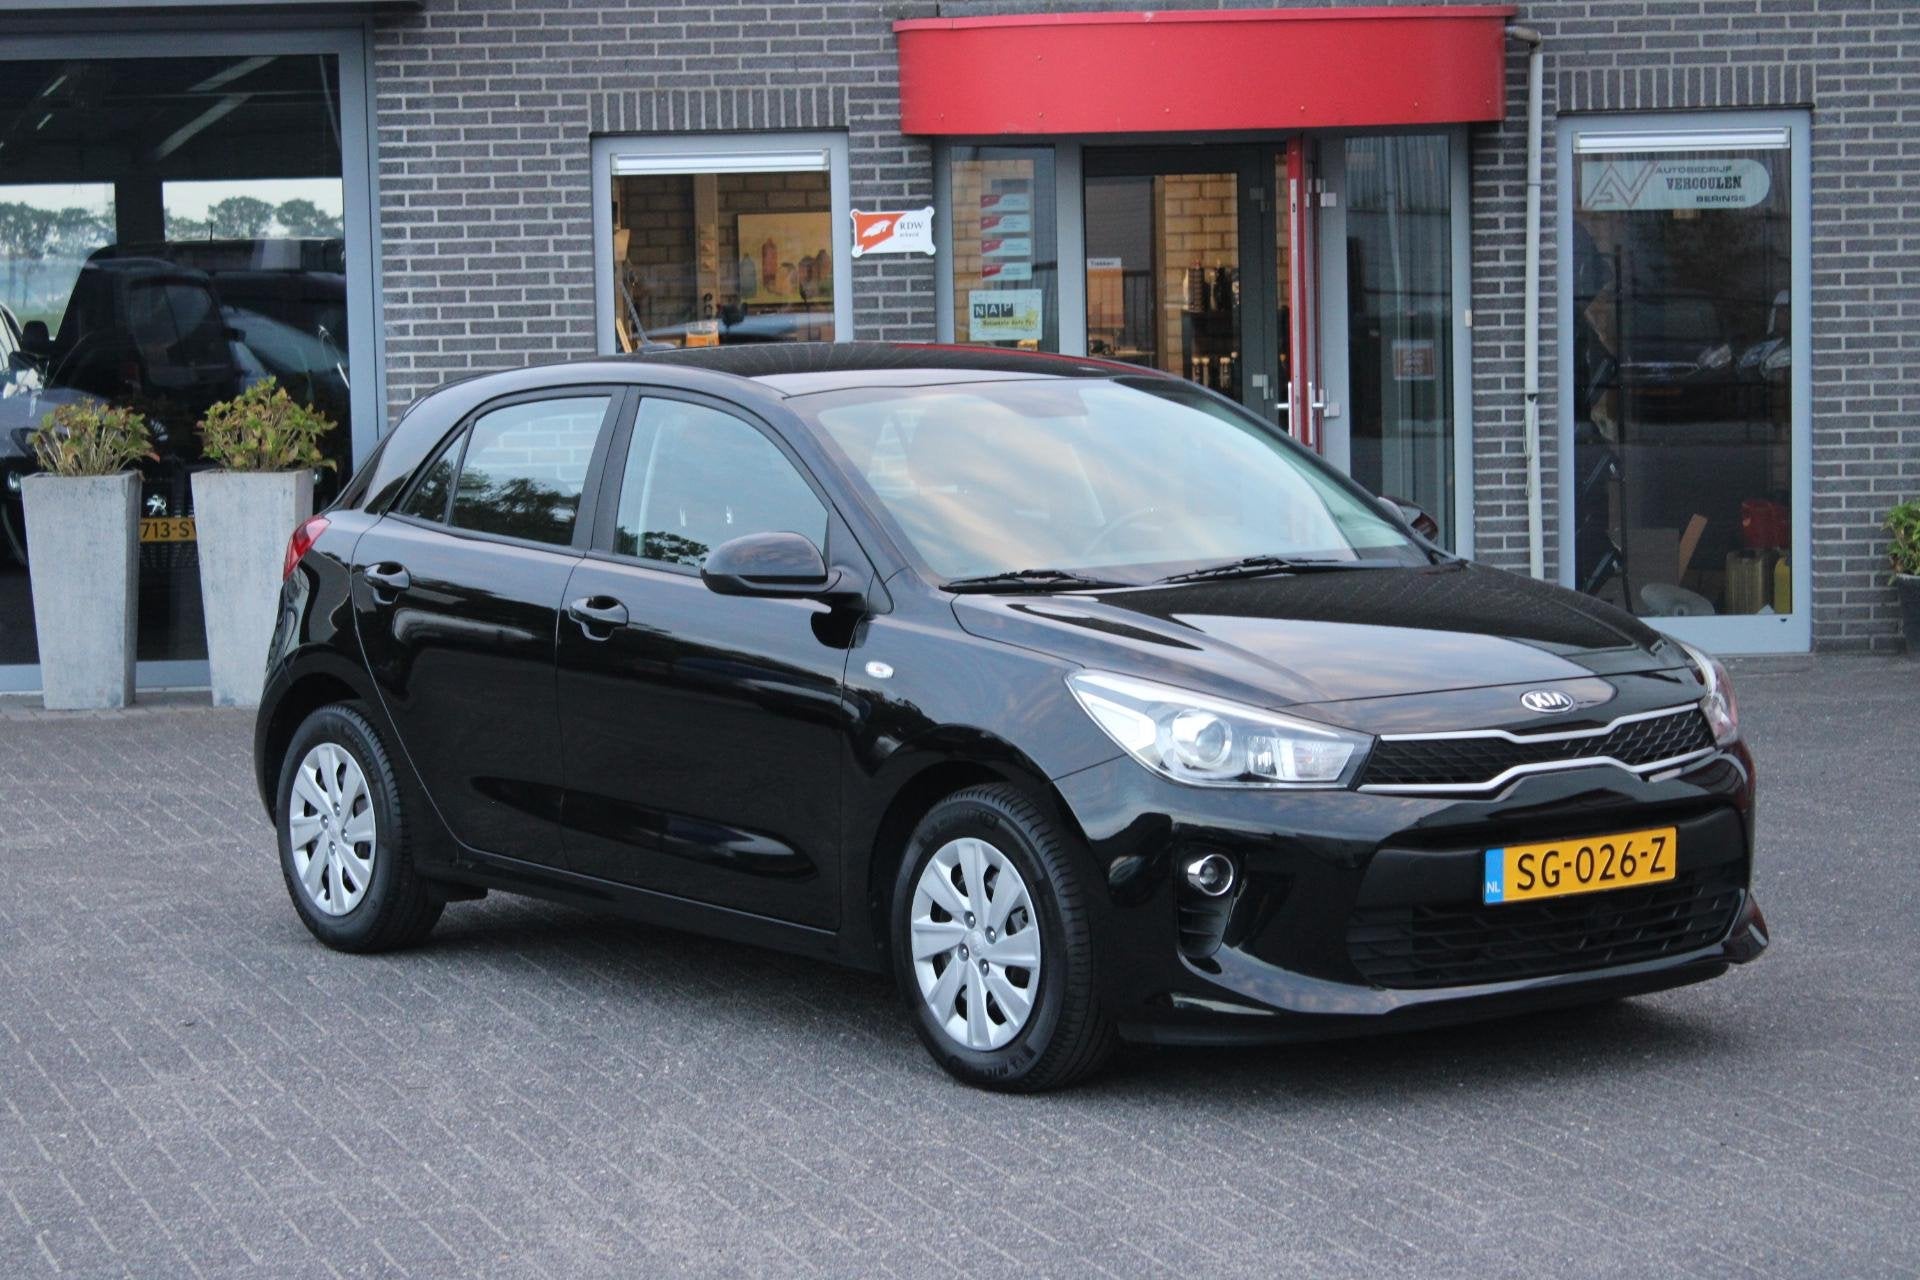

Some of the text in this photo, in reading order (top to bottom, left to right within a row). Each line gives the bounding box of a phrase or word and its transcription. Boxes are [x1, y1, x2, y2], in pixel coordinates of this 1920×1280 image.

[1666, 176, 1742, 190] VERCOULEN
[900, 221, 924, 231] RDW
[974, 302, 1013, 318] NAP
[1528, 692, 1570, 708] KIA
[1517, 836, 1667, 891] SG-026-Z
[1486, 881, 1501, 893] NL
